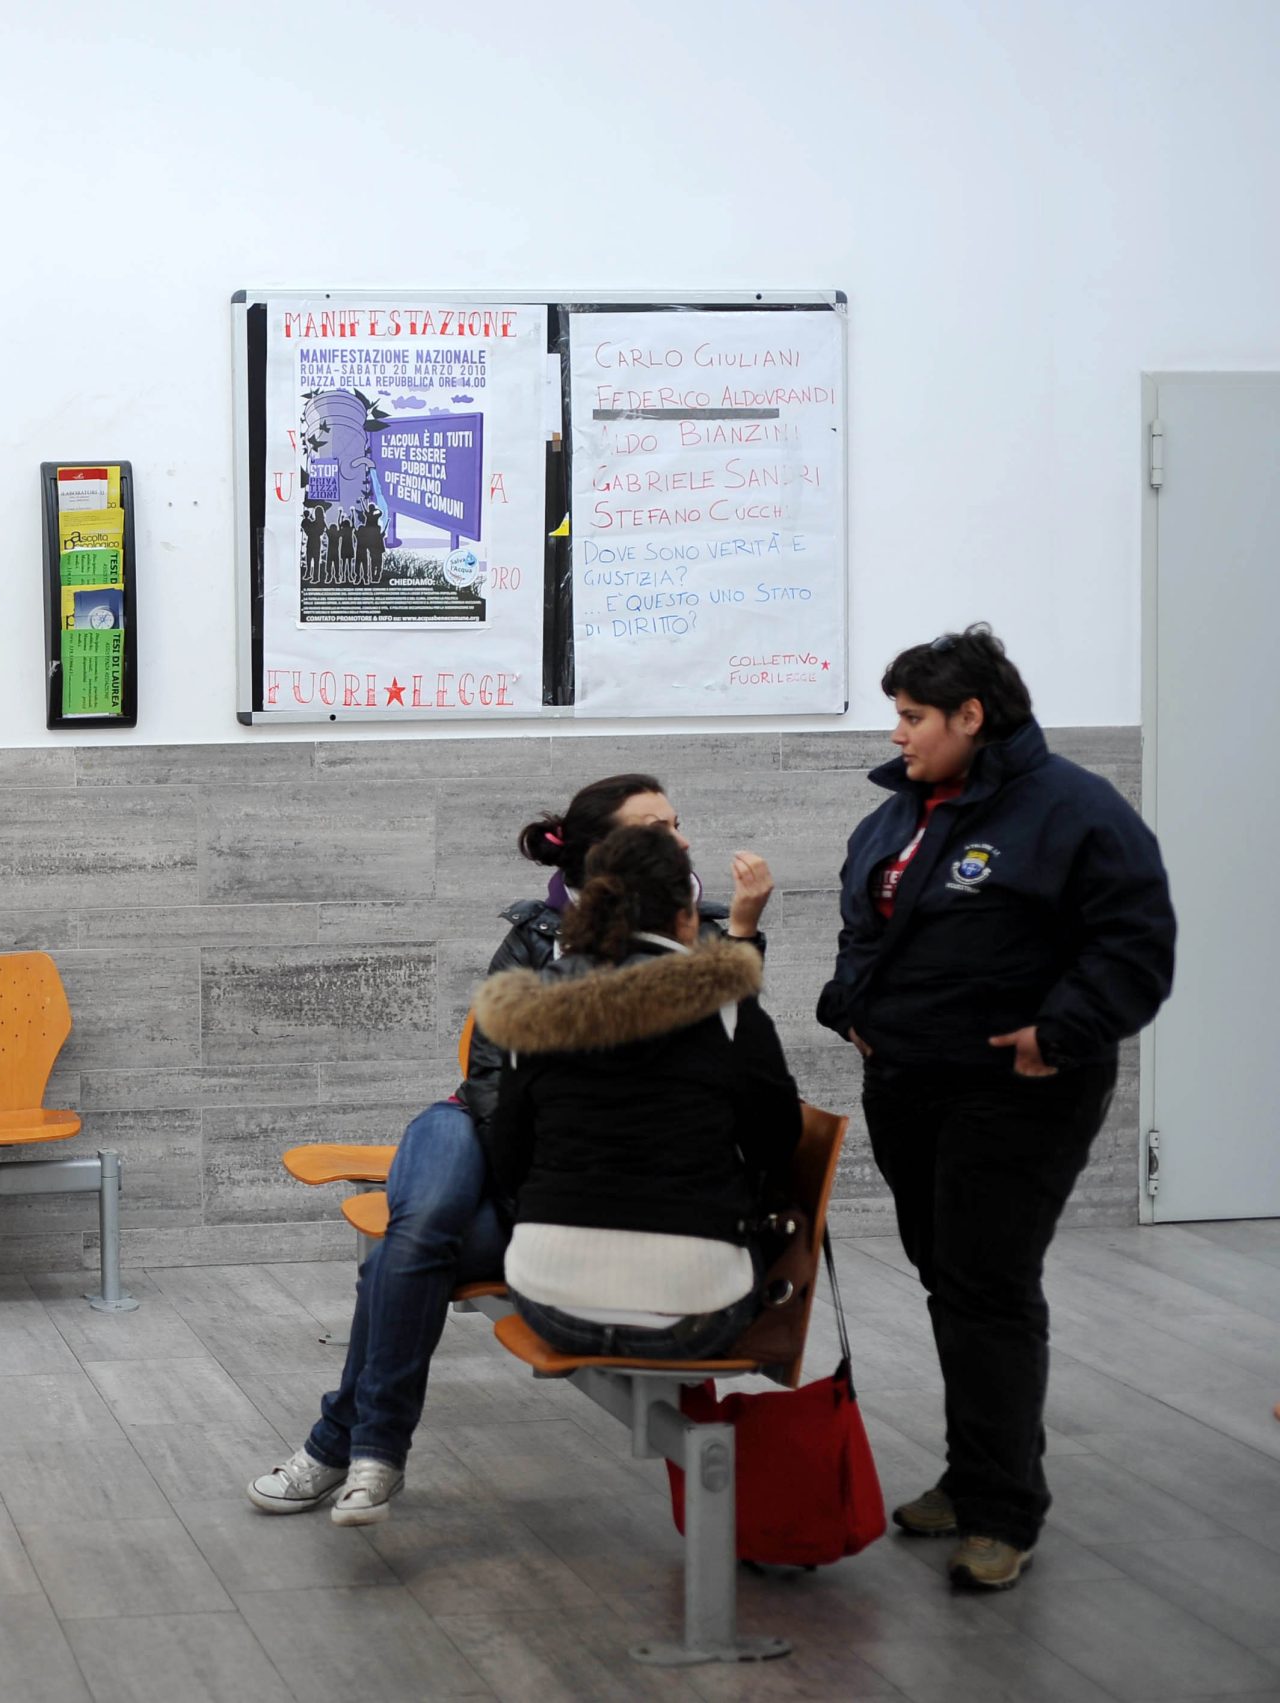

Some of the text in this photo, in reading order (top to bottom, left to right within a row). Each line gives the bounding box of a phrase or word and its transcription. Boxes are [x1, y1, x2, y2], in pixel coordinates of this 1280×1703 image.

[284, 310, 518, 338] MANIFESTAZIONE
[300, 349, 486, 364] MANIFESTAZIONE NAZIONALE
[595, 342, 800, 368] CARLO GIULIANI
[393, 364, 486, 376] 20 MARZO 2010
[300, 376, 486, 388] PIAZZA DELLA REPUBBLICA ORE 14.00
[596, 385, 835, 410] FEDERICO ALDOVRANDI
[381, 434, 420, 448] L'ACQUA
[434, 433, 443, 447] DI
[446, 431, 473, 448] TUTTI
[381, 444, 446, 463] DEVE ESSERE
[310, 464, 338, 477] STOP
[401, 460, 446, 480] PUBBLICA
[593, 465, 715, 492] GABRIELE
[384, 470, 441, 494] DIFENDIAMO
[389, 483, 464, 520] I BENI COMUNI
[590, 500, 701, 529] STEFANO
[584, 540, 636, 565] DOVE
[644, 543, 700, 561] SONO
[389, 578, 435, 586] CHIEDIAMO:
[584, 566, 688, 587] GIUSTIZIA?
[626, 583, 811, 612] QUESTO UNO STATO
[586, 623, 600, 636] DI
[113, 656, 120, 668] DI
[729, 652, 818, 667] COLLETTIVO
[112, 671, 120, 707] LAUREA
[267, 670, 516, 707] FUORI LEGGE
